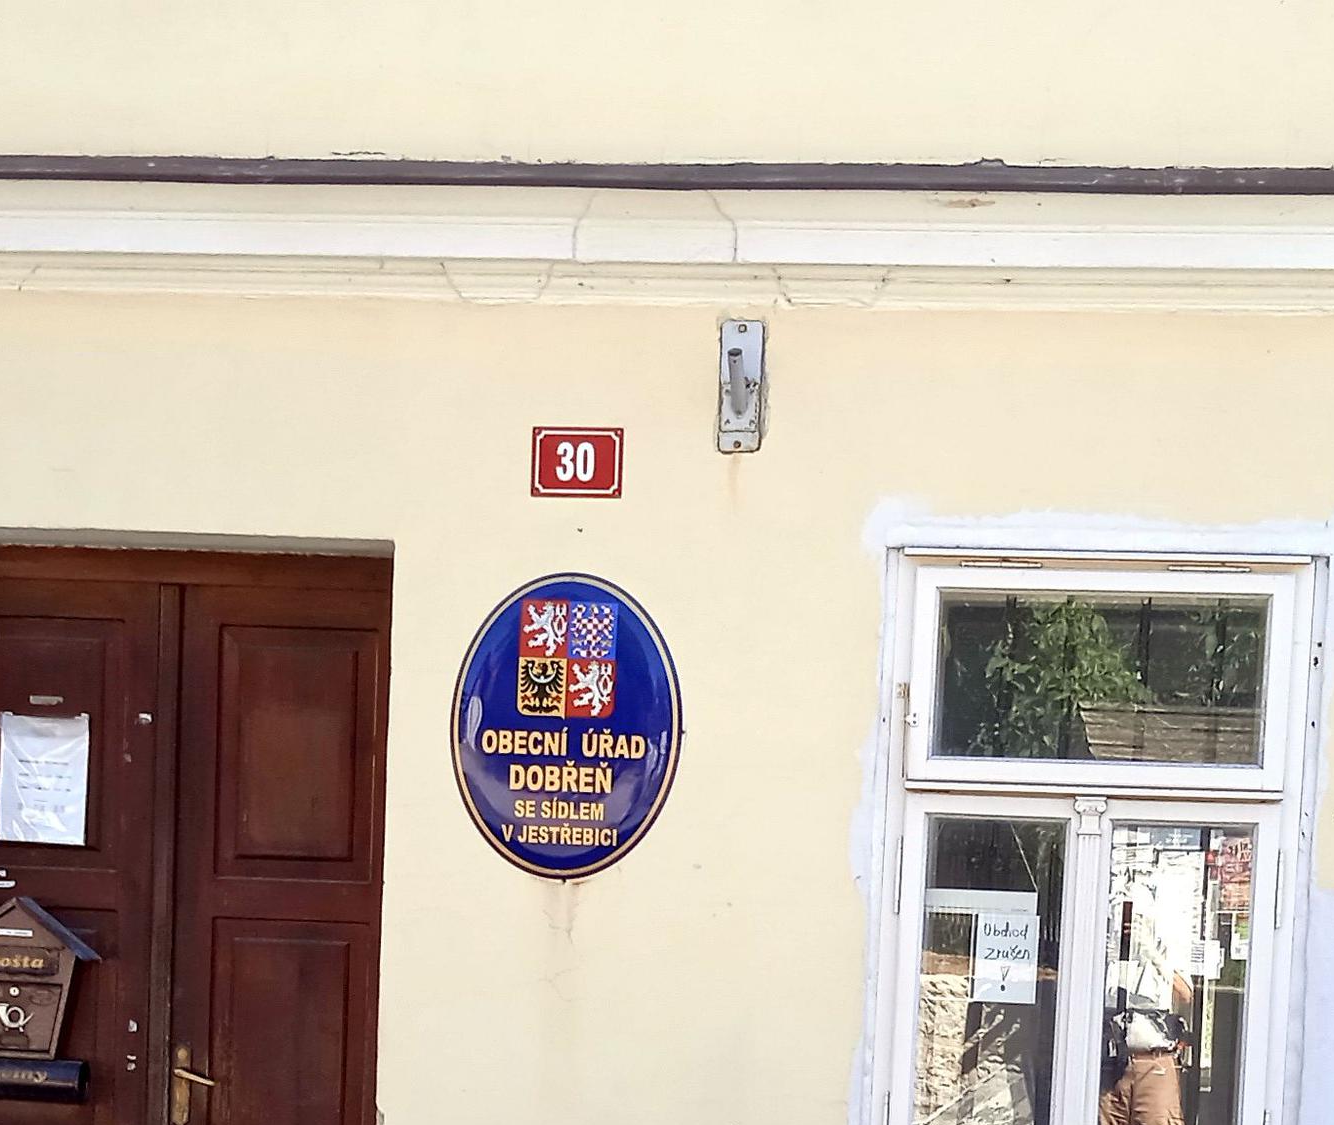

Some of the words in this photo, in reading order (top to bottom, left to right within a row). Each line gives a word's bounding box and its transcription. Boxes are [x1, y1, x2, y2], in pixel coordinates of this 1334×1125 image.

[556, 441, 595, 482] 30
[482, 727, 568, 756] OBECNÍ
[582, 728, 646, 759] ÚŘAD
[510, 760, 612, 794] DOBŘEŇ
[515, 800, 536, 818] SE
[541, 797, 604, 821] SÍDLEM
[501, 824, 514, 842] V
[518, 823, 617, 847] JESTŘEBICI
